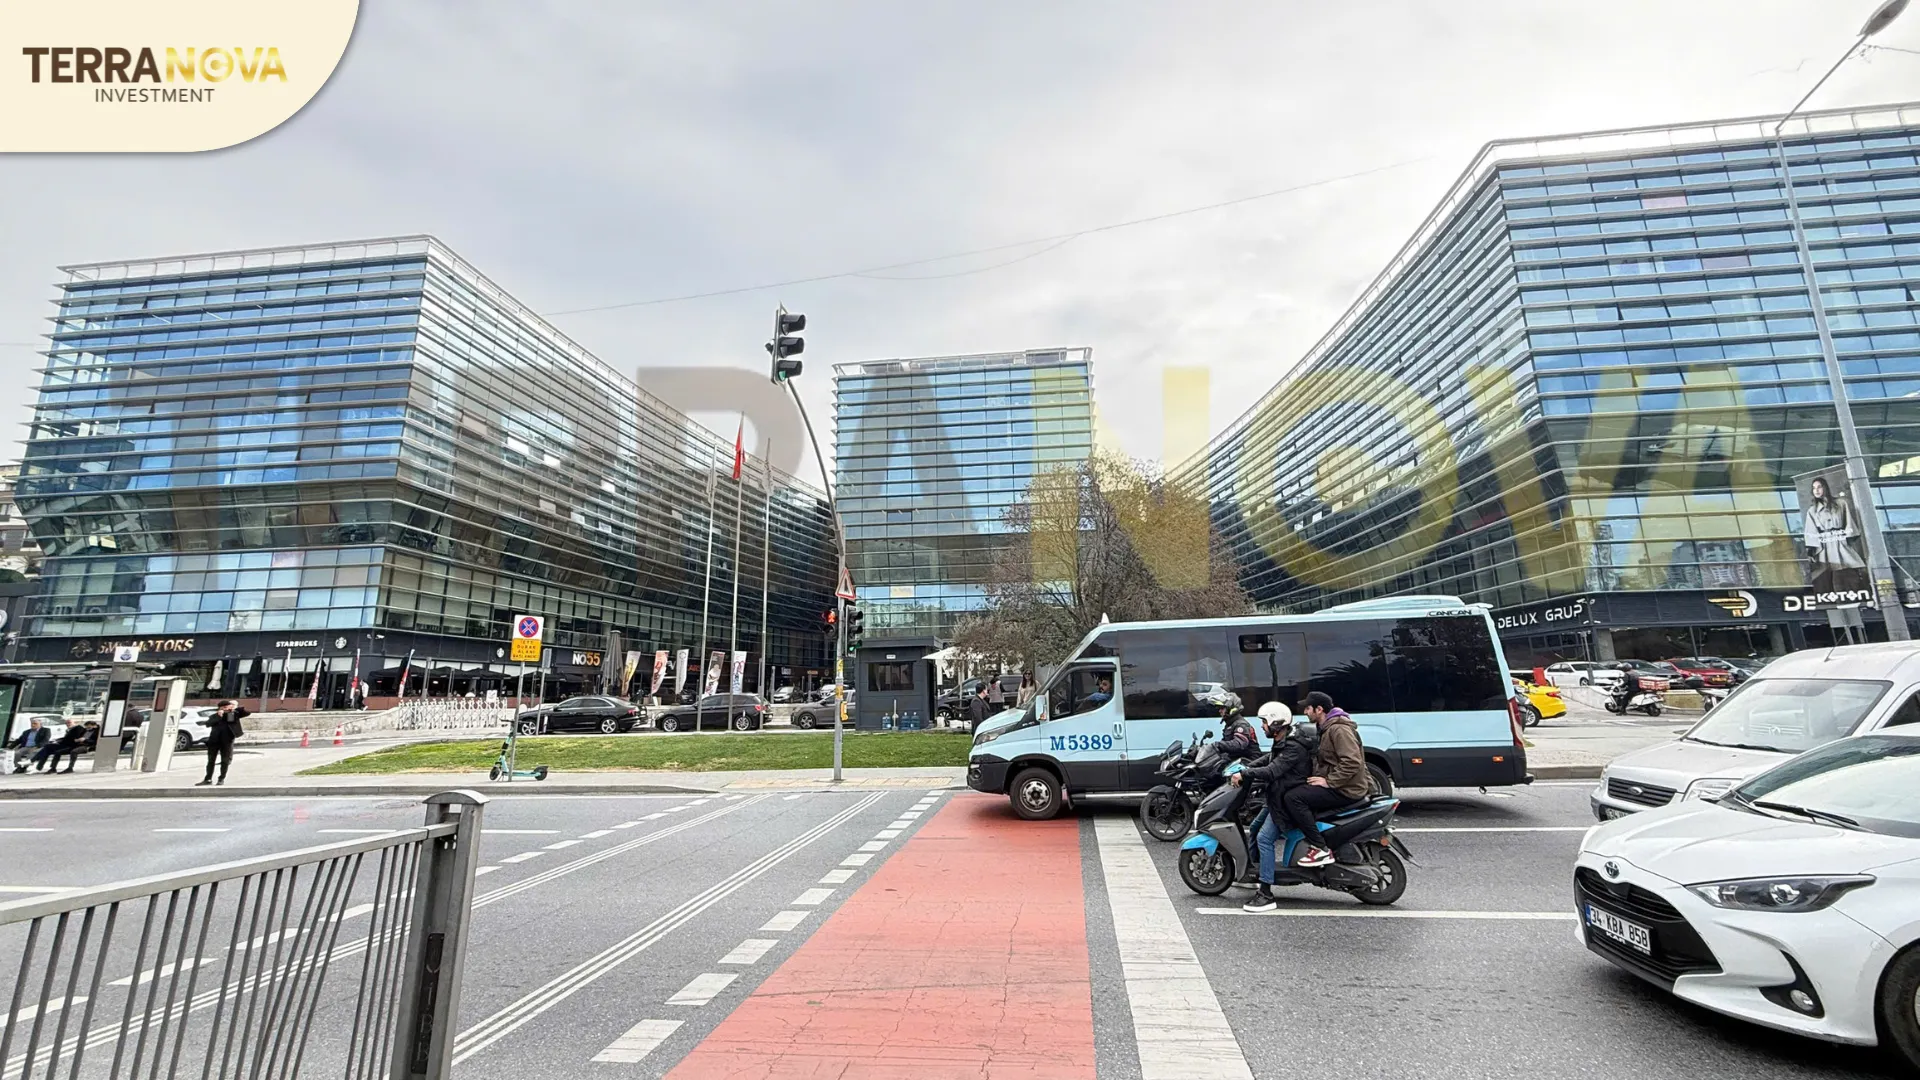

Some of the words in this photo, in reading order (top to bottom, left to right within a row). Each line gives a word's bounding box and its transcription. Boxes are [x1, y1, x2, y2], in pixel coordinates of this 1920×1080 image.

[1498, 612, 1538, 628] DELUX
[1545, 604, 1582, 621] GRUP
[276, 640, 318, 648] STARBUCKS
[572, 652, 600, 666] NO55
[1590, 908, 1602, 926] 34
[1606, 914, 1624, 937] KBA
[1629, 925, 1648, 947] 858
